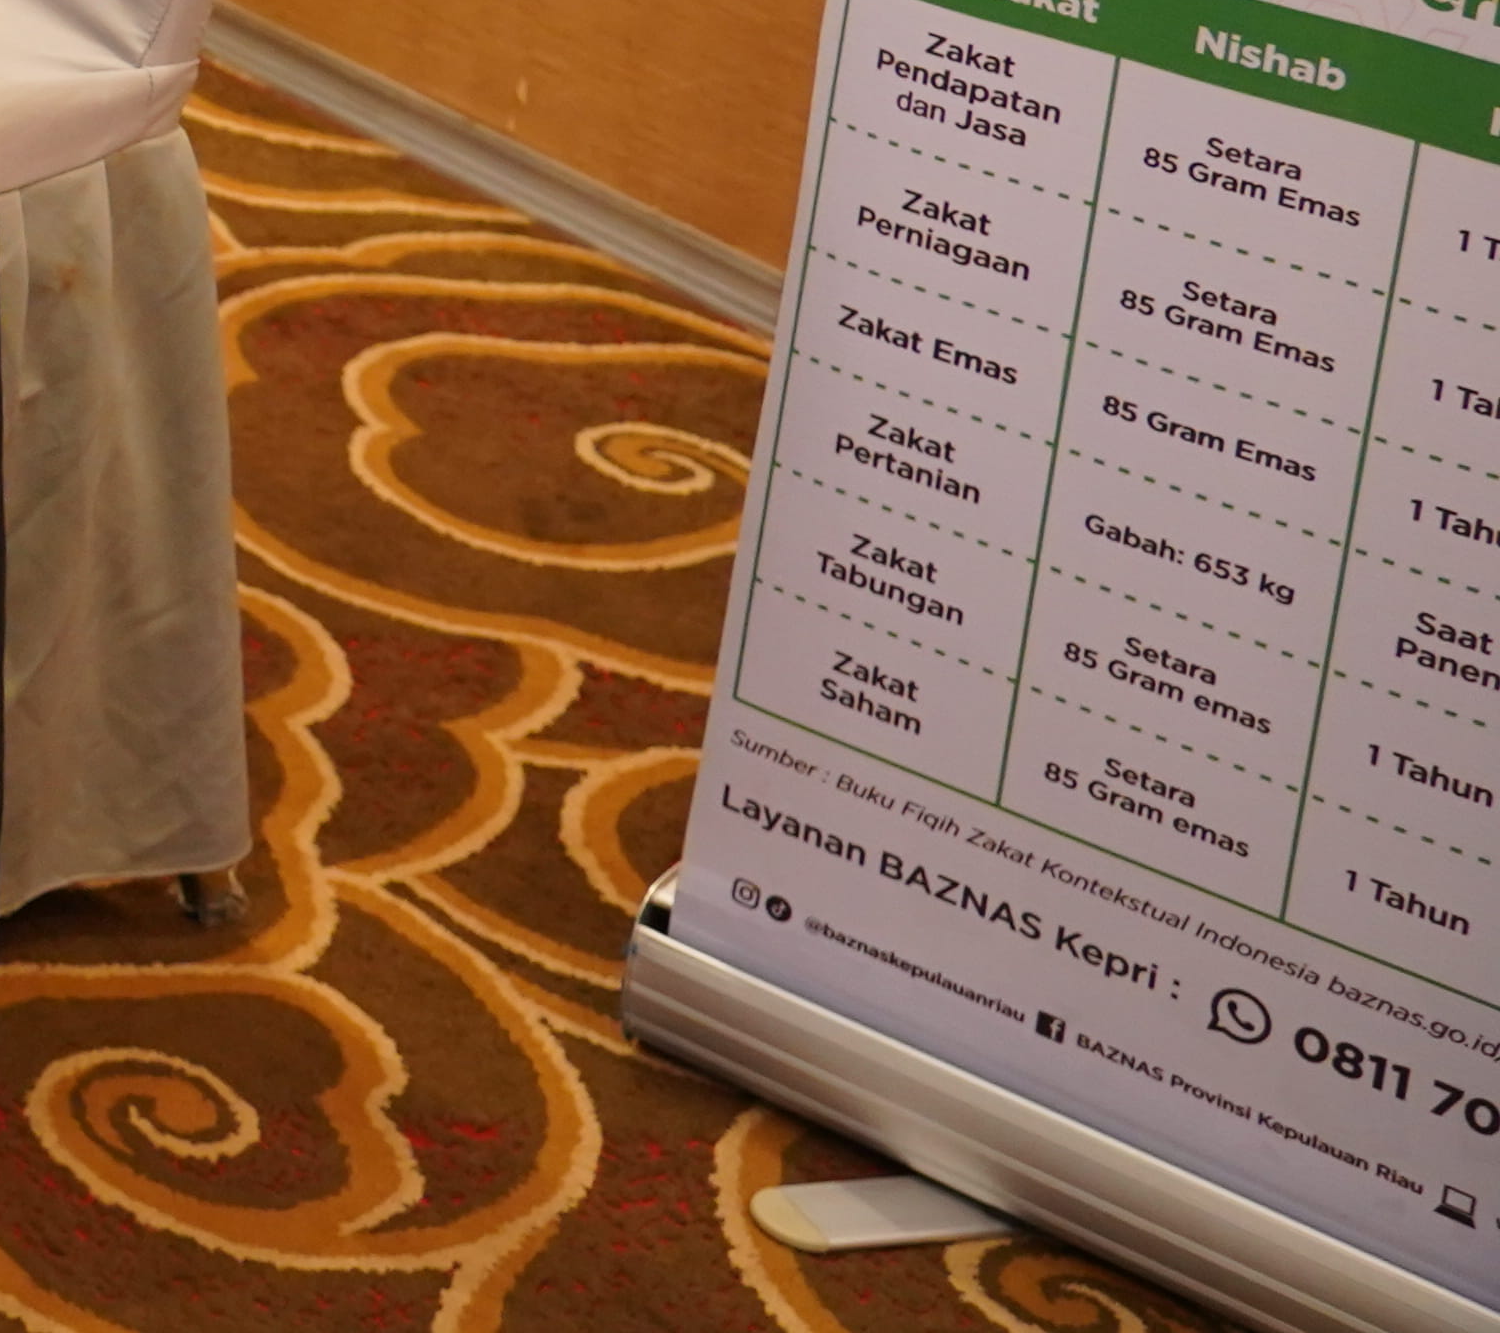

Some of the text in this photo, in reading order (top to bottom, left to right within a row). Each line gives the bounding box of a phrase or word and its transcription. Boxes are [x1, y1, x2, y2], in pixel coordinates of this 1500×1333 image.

[877, 48, 1061, 124] Pendapatan
[925, 32, 1016, 78] Zakat
[1194, 25, 1347, 91] Nishab
[896, 91, 1027, 147] dan Jasa
[1142, 147, 1362, 228] 85 Gram Emas
[1205, 136, 1303, 181] Setara
[856, 205, 1031, 281] Perniagaan
[901, 189, 993, 237] Zakat
[1459, 230, 1471, 252] 1
[1119, 289, 1336, 374] 85 Gram Emas
[1182, 280, 1278, 326] Setara
[836, 305, 1019, 385] Zakat Emas
[1432, 379, 1444, 401] 1
[835, 433, 981, 504] Pertanian
[867, 413, 957, 463] Zakat
[1102, 395, 1318, 483] 85 Gram Emas
[1411, 499, 1423, 521] 1
[816, 552, 965, 626] Tabungan
[850, 534, 938, 584] Zakat
[1084, 513, 1295, 607] Gabah: 653 kg
[1124, 636, 1218, 686] Setara
[1395, 637, 1500, 690] Panen
[1416, 611, 1493, 656] Saat
[820, 678, 922, 735] Saham
[832, 651, 920, 703] Zakat
[1064, 642, 1272, 735] 85 Gram emas
[1103, 757, 1196, 809] Setara
[1368, 744, 1493, 807] 1 Tahun
[1043, 761, 1249, 859] 85 Gram emas
[722, 785, 866, 866] Layanan
[880, 850, 1042, 940] BAZNAS
[1055, 926, 1159, 990] Kepri
[730, 729, 818, 777] Sumber
[836, 774, 896, 810] Buku
[901, 801, 960, 837] Fiqih
[966, 827, 1037, 868] Zakat
[1041, 858, 1191, 932] Kontekstual
[1195, 921, 1320, 985] Indonesia
[1346, 870, 1470, 935] 1 Tahun
[804, 915, 1025, 1023] @baznaskepulauanriau
[1077, 1033, 1424, 1195] BAZNAS Provinsi Kepulauan Riau
[1294, 1027, 1500, 1136] 0811 70
